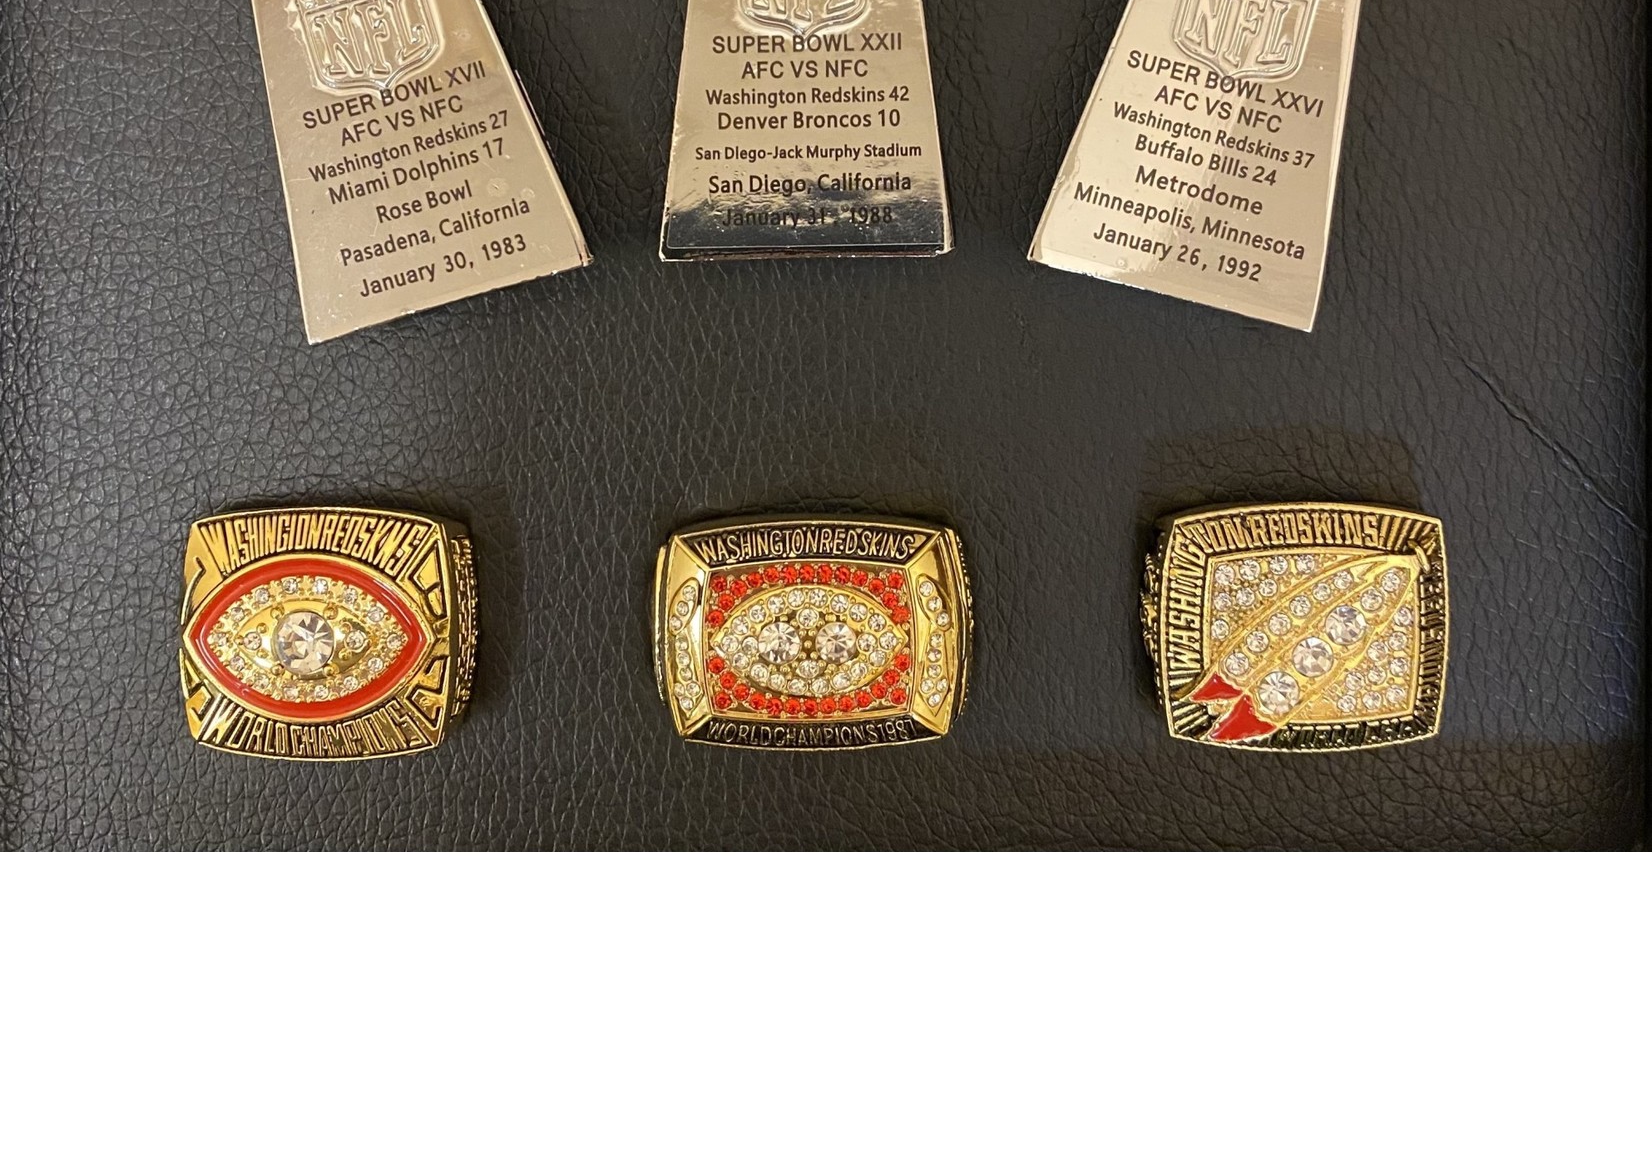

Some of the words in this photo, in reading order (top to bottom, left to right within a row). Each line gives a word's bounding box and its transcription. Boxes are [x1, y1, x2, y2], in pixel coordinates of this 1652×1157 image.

[712, 35, 786, 54] SUPER
[792, 34, 854, 52] BOWL
[860, 33, 902, 51] XXII
[303, 93, 376, 129] SUPER
[381, 78, 442, 107] BOWL
[447, 61, 485, 87] XVII
[742, 61, 783, 80] AFC
[790, 60, 818, 78] VS
[826, 59, 868, 77] NFC
[1127, 50, 1200, 85] SUPER
[1205, 71, 1266, 103] BOWL
[1271, 89, 1324, 117] XXVI
[341, 119, 382, 146] AFC
[386, 109, 415, 131] VS
[420, 95, 463, 123] NFC
[706, 89, 806, 108] Washington
[812, 87, 885, 103] Redskins
[889, 86, 909, 102] 42
[718, 112, 787, 130] Denver
[794, 111, 871, 128] Broncos
[878, 109, 900, 126] 10
[1154, 85, 1198, 111] AFC
[1205, 96, 1231, 119] VS
[1237, 107, 1282, 133] NFC
[309, 137, 411, 182] Washington
[415, 119, 487, 153] Redskins
[489, 111, 509, 130] 27
[696, 147, 720, 160] San
[725, 145, 802, 162] Diego-Jack
[806, 145, 860, 160] Murphy
[864, 144, 922, 157] Stadium
[1114, 102, 1211, 142] Washington
[1215, 130, 1289, 163] Redskins
[1295, 151, 1314, 168] 37
[1135, 134, 1203, 167] Buffalo
[1209, 154, 1248, 179] Bills
[1252, 166, 1276, 186] 24
[329, 172, 389, 204] Miami
[393, 149, 479, 187] Dolphins
[483, 138, 504, 159] 17
[709, 176, 743, 193] San
[750, 176, 812, 196] Diego,
[818, 172, 911, 191] California
[1135, 165, 1263, 215] Metrodome
[376, 199, 422, 223] Rose
[426, 181, 472, 209] Bowl
[722, 208, 805, 227] January
[848, 206, 892, 224] 1988
[1074, 182, 1196, 232] Minneapolis,
[1202, 217, 1305, 260] Minnesota
[340, 228, 436, 266] Pasadena,
[439, 198, 530, 237] California
[1094, 223, 1171, 260] January
[1177, 244, 1207, 271] 26,
[1218, 255, 1261, 281] 1992
[359, 263, 436, 298] January
[443, 252, 474, 273] 30,
[481, 234, 527, 262] 1983
